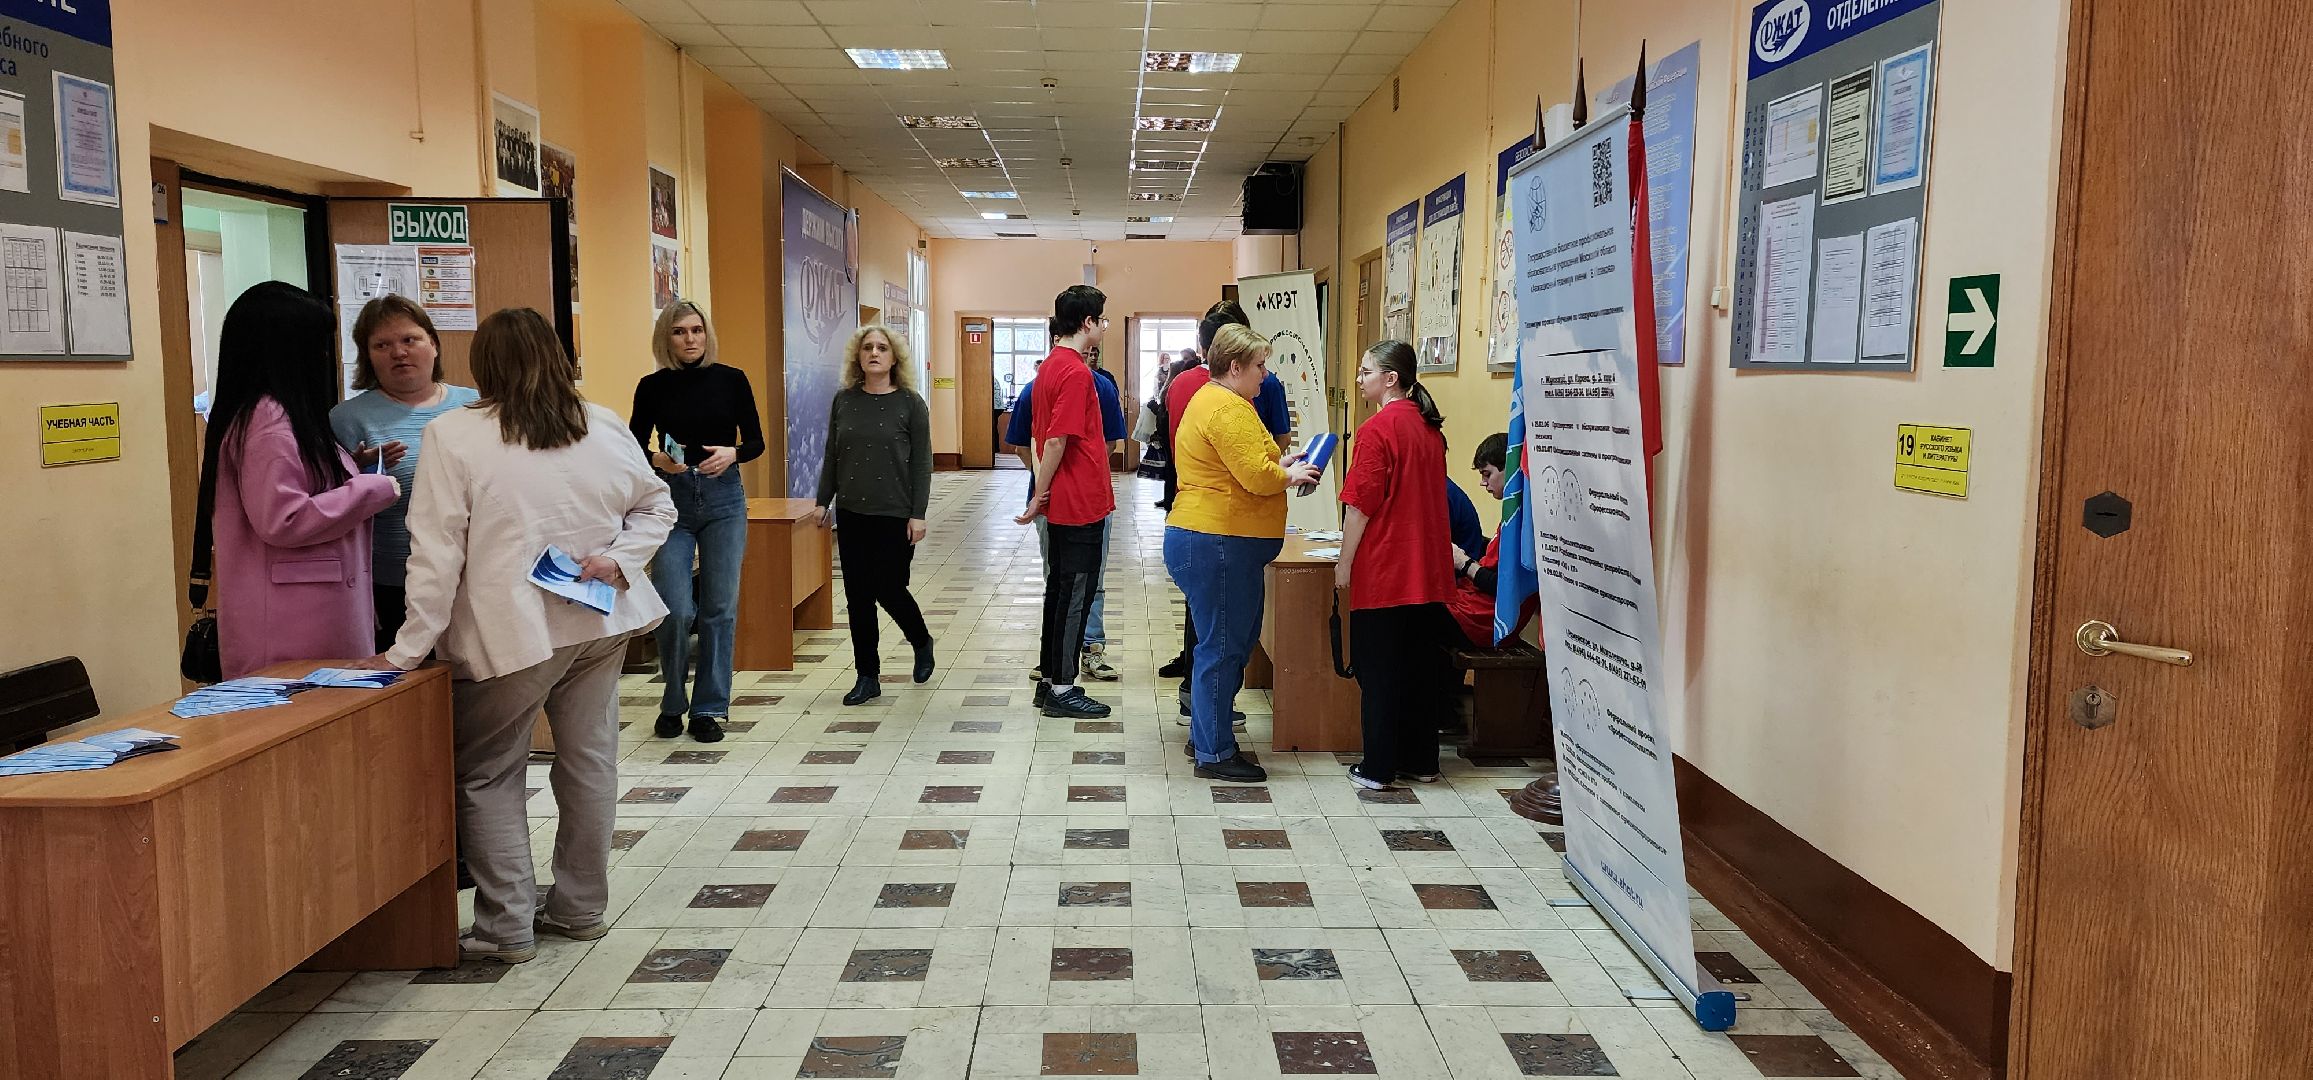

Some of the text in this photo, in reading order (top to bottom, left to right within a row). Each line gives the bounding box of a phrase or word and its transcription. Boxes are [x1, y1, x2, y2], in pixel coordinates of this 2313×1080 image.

[392, 210, 466, 240] ВЫХОД
[1736, 216, 1749, 345] Расписание
[1268, 290, 1298, 309] КРЭТ
[1269, 329, 1320, 394] РОФЕССИОНАЛИТЕТ
[46, 415, 115, 431] УЧЕБНАЯ ЧАСТЬ
[1899, 433, 1914, 456] 19
[1930, 434, 1953, 443] КАБИНЕТ
[1919, 443, 1963, 454] РУССКОГО ЯЗЫКА
[1927, 453, 1959, 463] ЛИТЕРАТУРЫ
